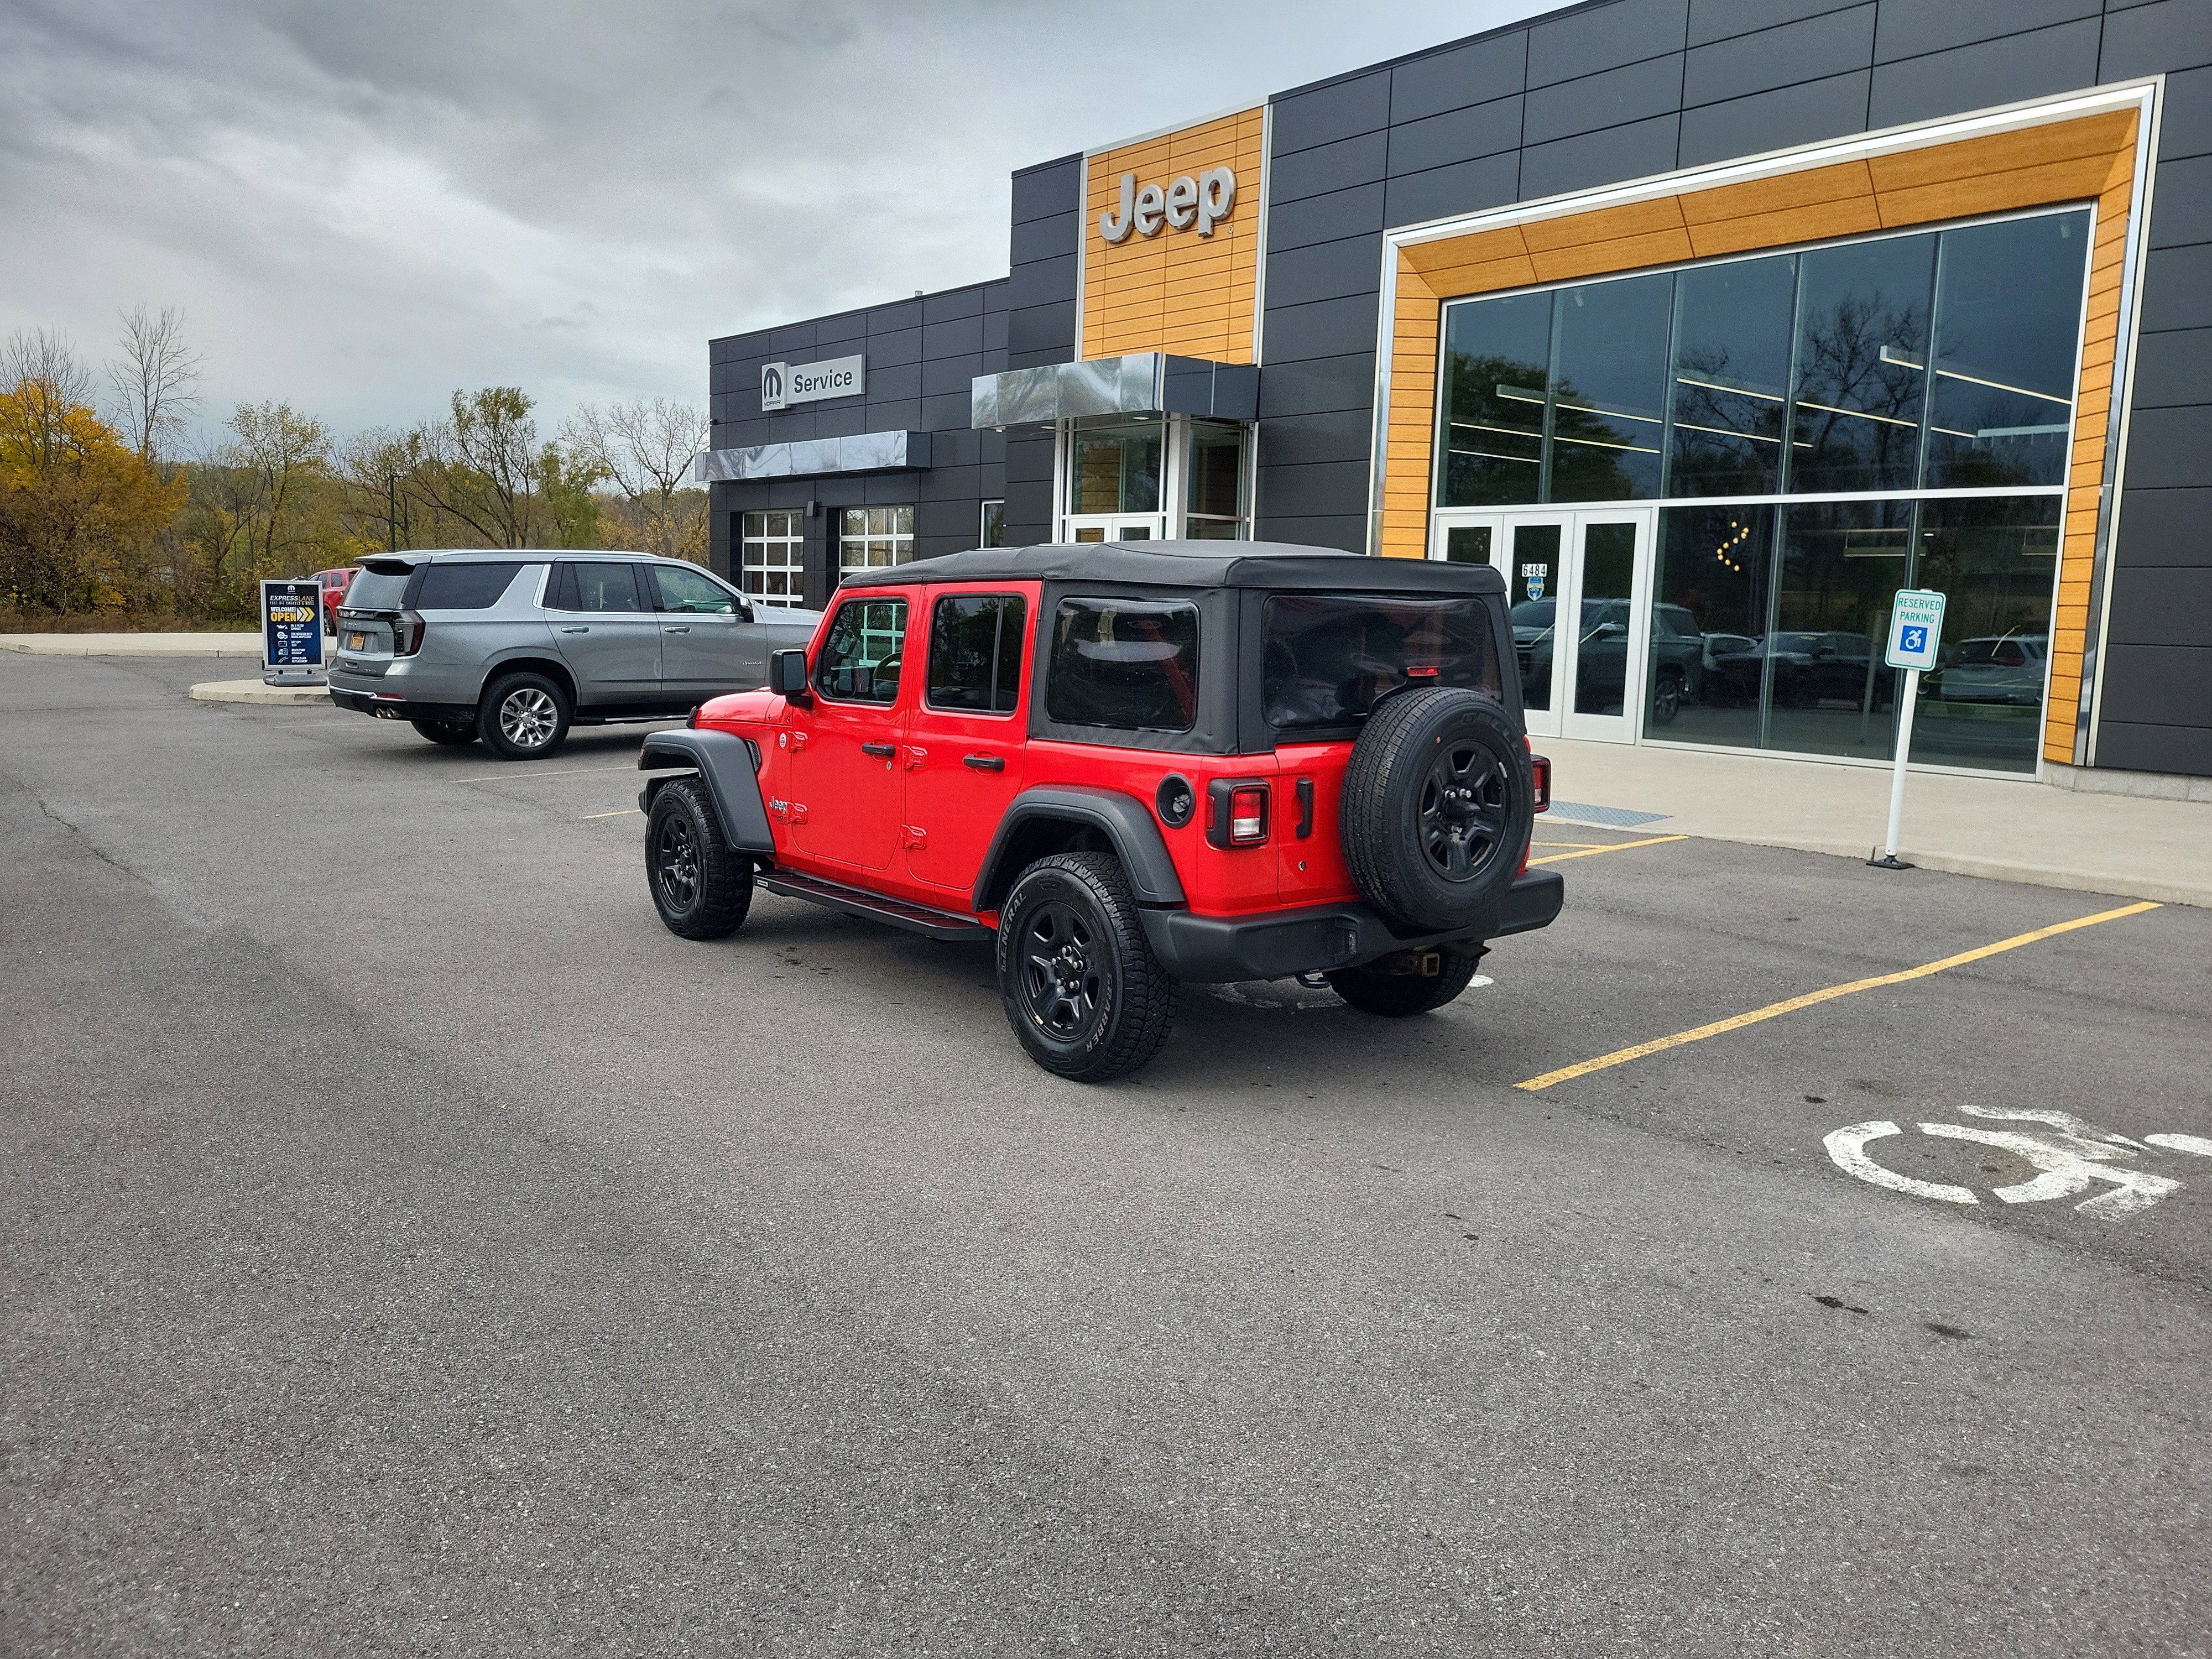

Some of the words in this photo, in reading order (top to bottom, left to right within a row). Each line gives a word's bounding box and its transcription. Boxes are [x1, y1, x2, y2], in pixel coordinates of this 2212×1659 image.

[1099, 165, 1237, 243] Jeep
[794, 369, 853, 394] Service
[1523, 565, 1546, 576] 6484
[1898, 597, 1941, 611] RESERVED
[270, 612, 297, 622] OPEN
[1900, 611, 1935, 624] PARKING
[769, 796, 787, 815] Jeep
[1001, 892, 1027, 972] GENERAL
[1086, 972, 1113, 1053] GRABBER
